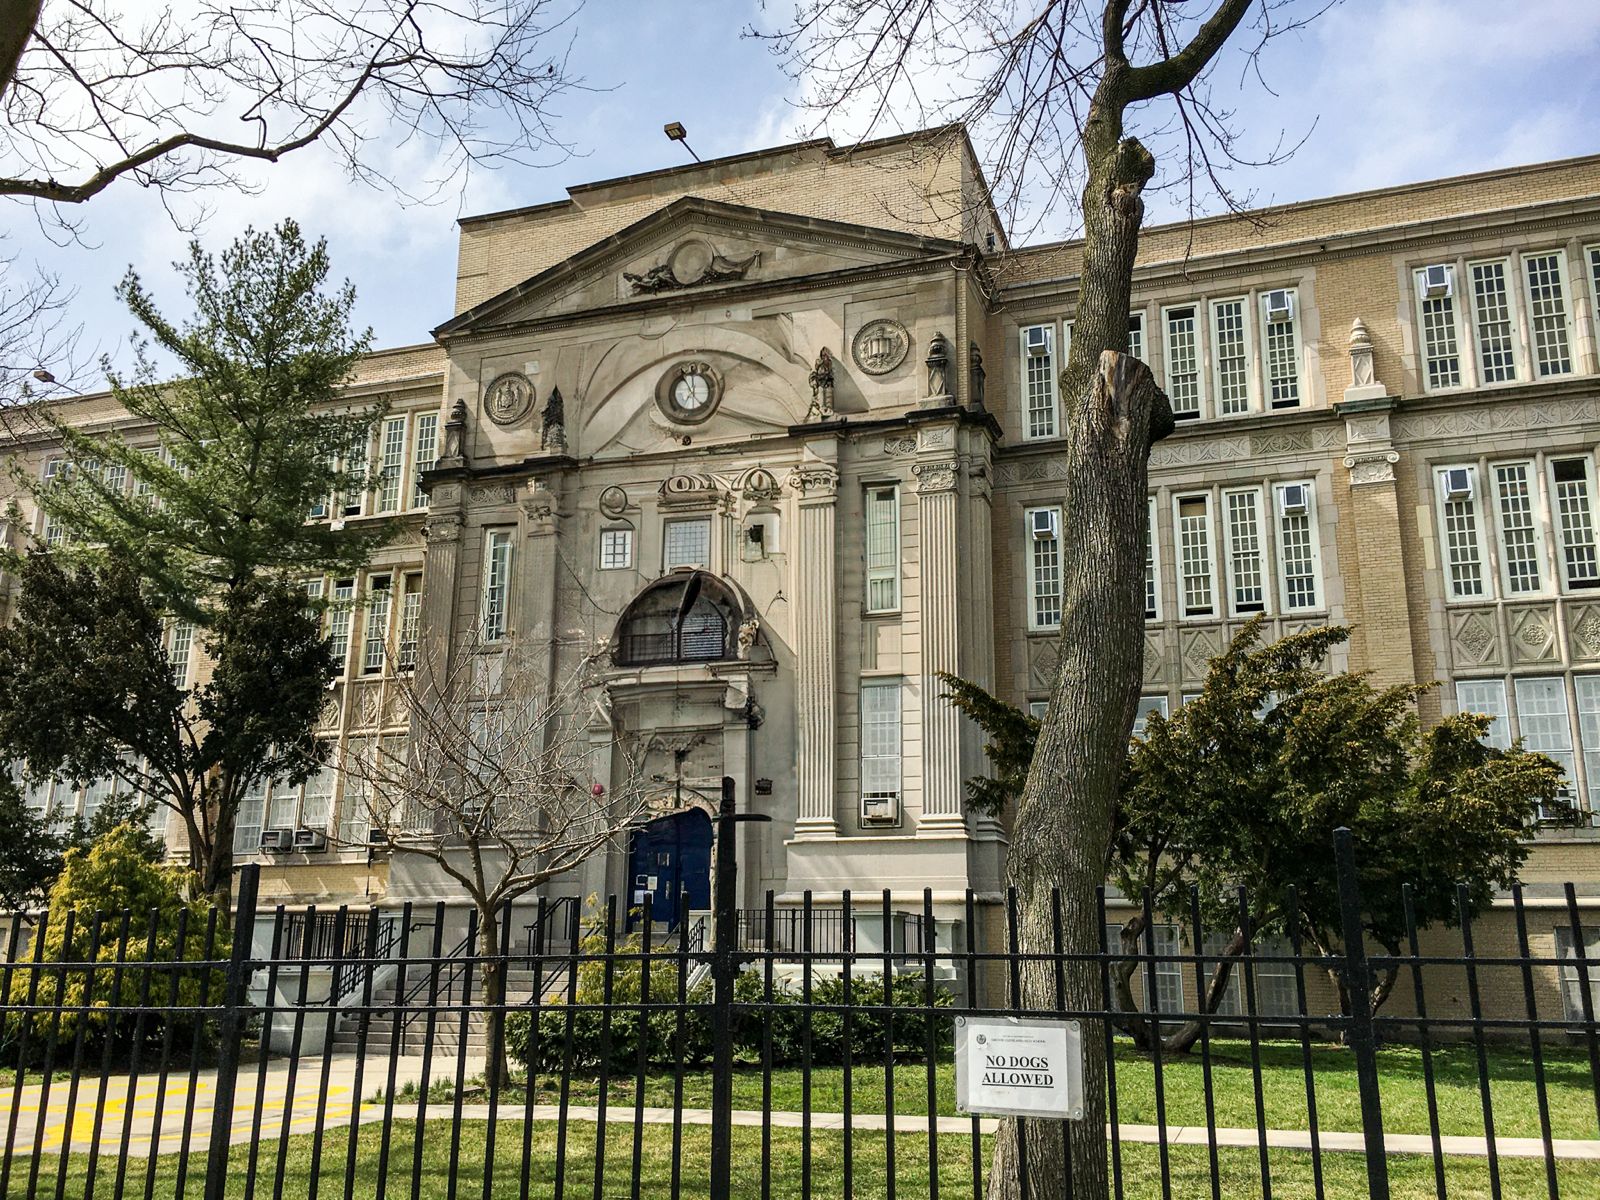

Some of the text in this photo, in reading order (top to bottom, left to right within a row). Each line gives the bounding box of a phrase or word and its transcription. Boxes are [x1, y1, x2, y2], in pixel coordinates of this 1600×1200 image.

[986, 1055, 1049, 1069] NO DOGS
[982, 1072, 1054, 1086] ALLOWED
